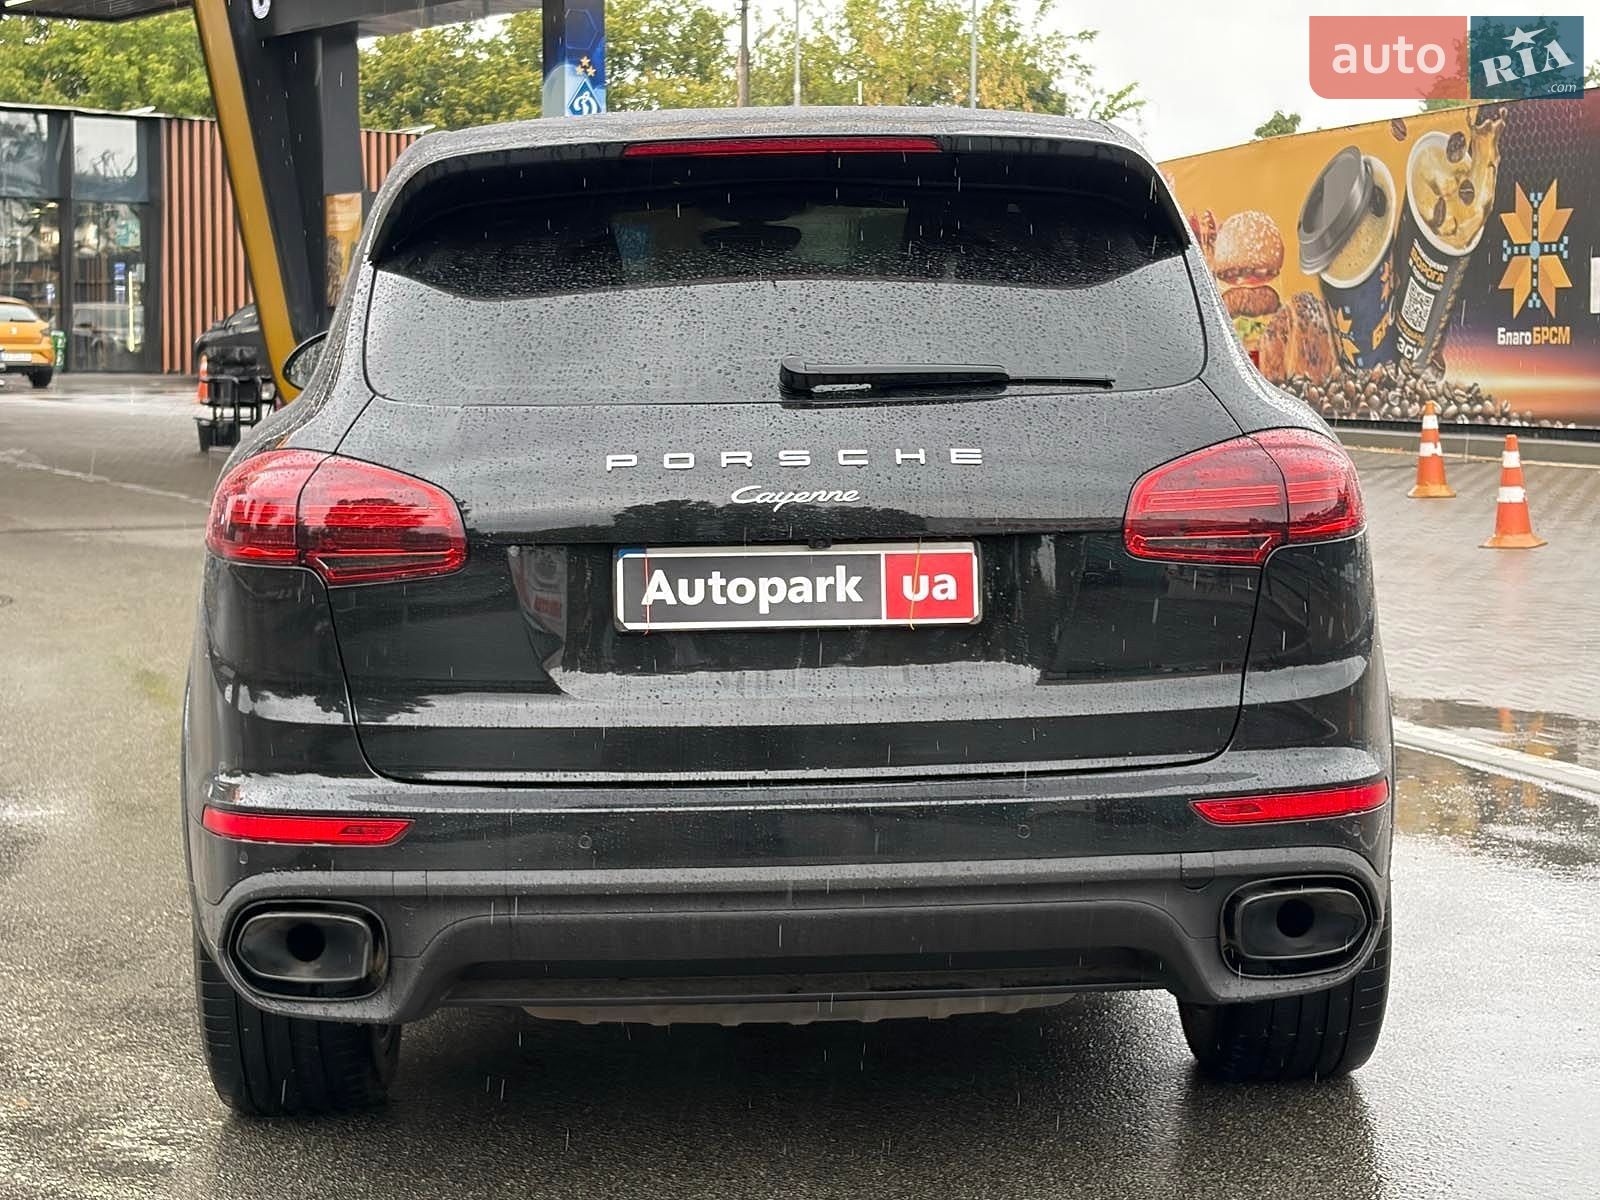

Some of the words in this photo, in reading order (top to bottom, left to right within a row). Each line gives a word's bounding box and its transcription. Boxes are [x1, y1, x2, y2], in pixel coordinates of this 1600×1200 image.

[606, 447, 983, 472] PORSCHE
[731, 484, 861, 512] Cayenne
[641, 565, 863, 615] Autopark
[901, 573, 958, 602] ua
